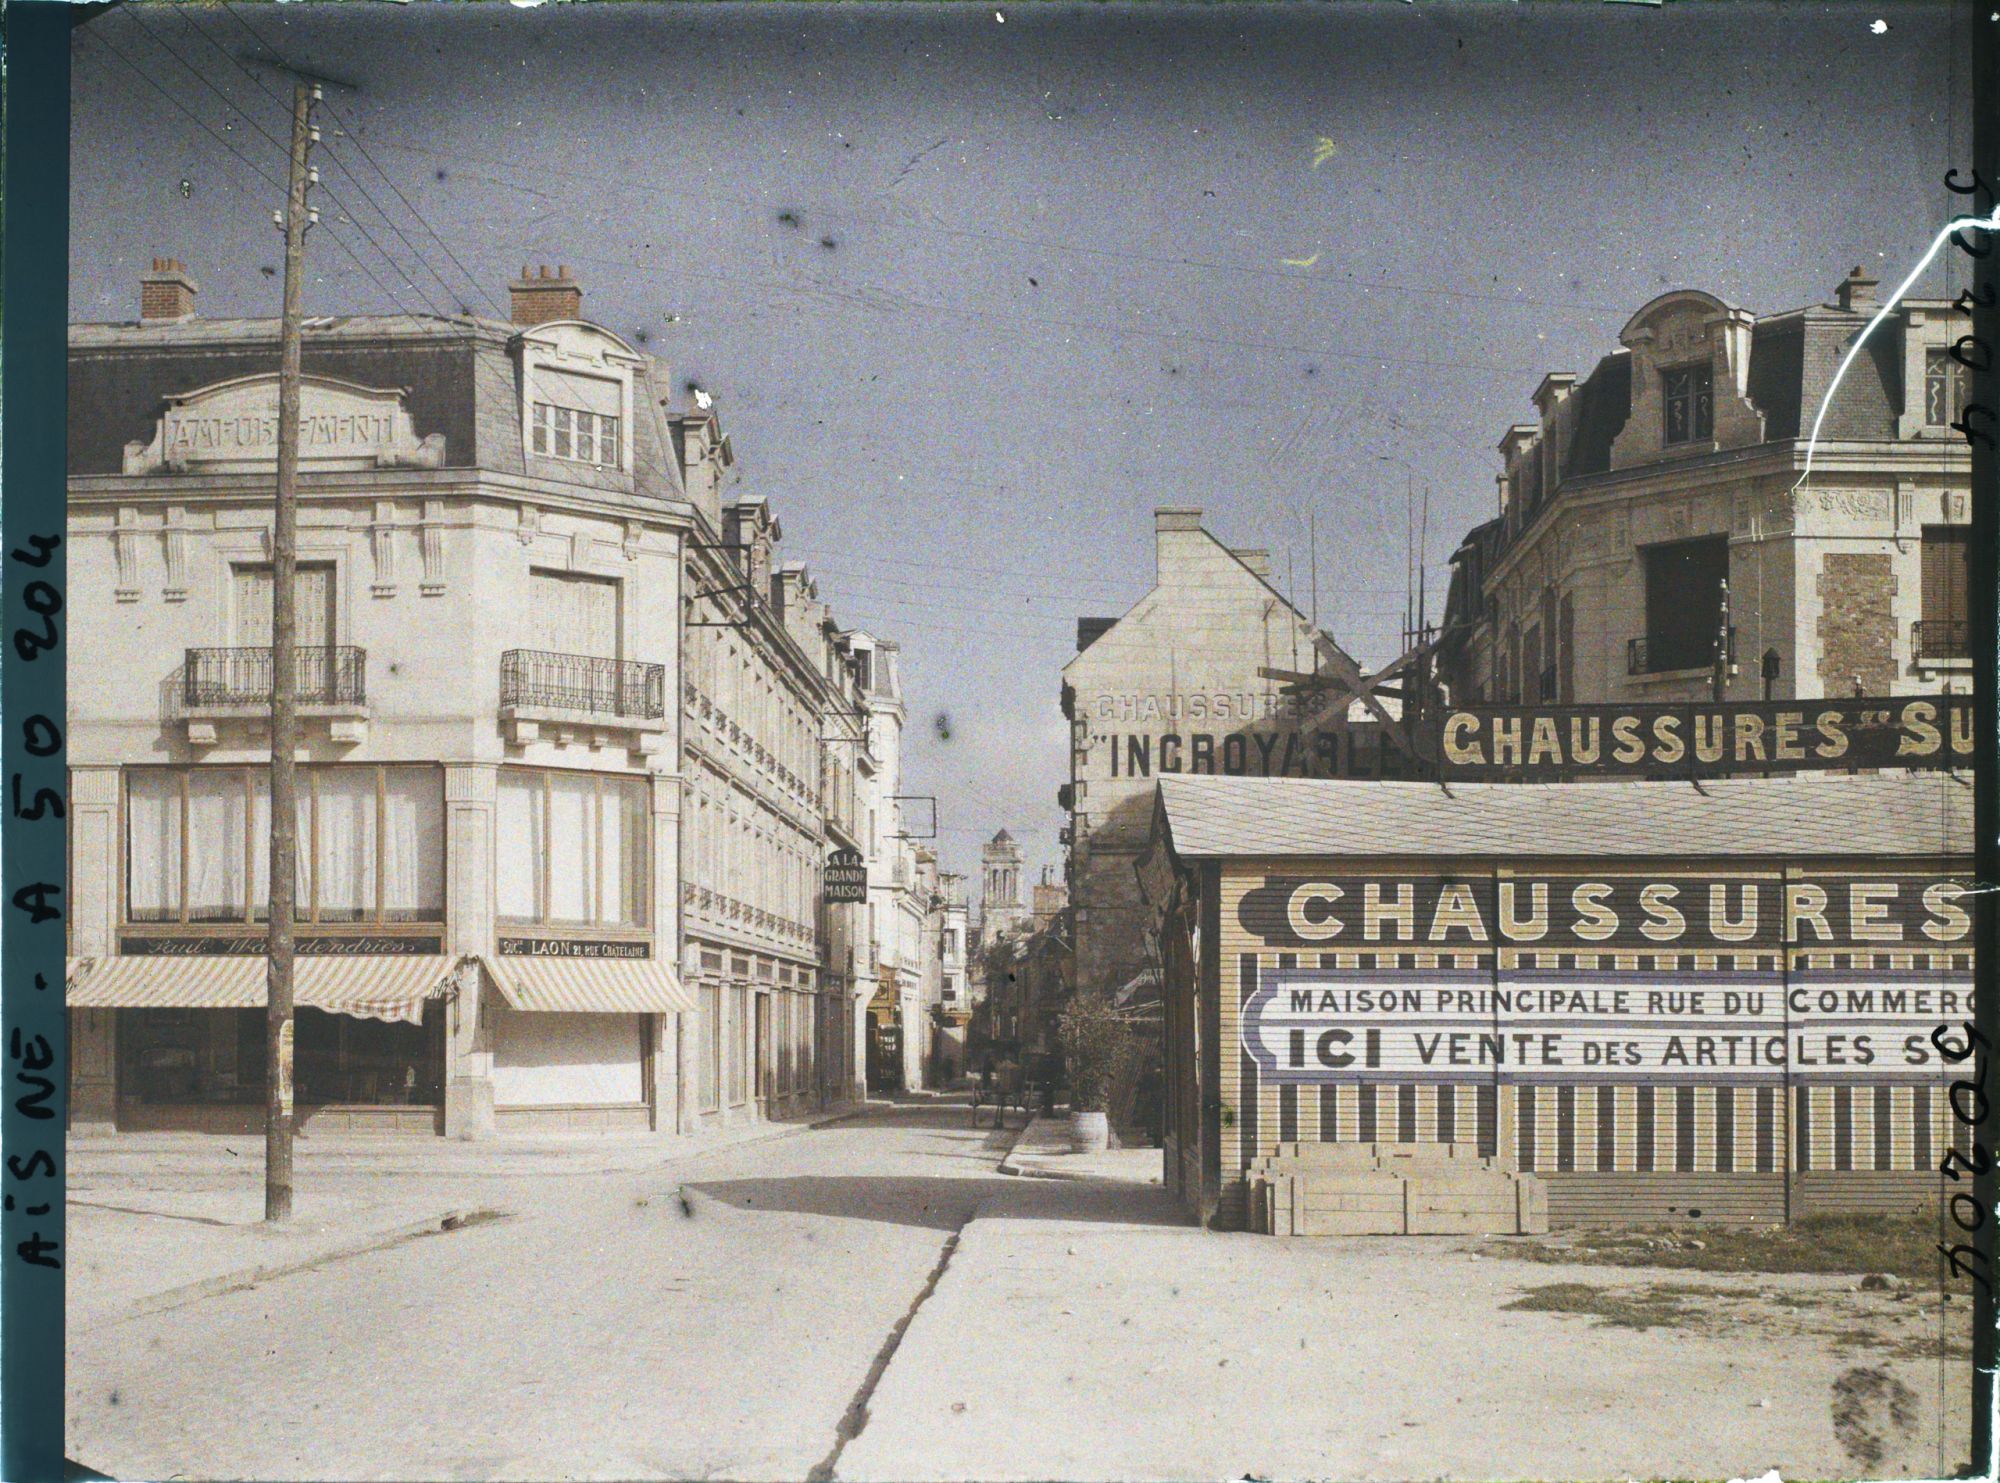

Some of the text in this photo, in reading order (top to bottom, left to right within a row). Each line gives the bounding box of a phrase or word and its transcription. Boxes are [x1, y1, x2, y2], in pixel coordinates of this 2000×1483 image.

[1443, 711, 1850, 766] CHAUSSURES
[832, 853, 858, 866] A LA
[824, 869, 866, 882] GRANDE
[824, 885, 866, 898] MAISON
[1286, 882, 1971, 943] CHAUSSURES
[531, 940, 570, 955] LAON
[585, 946, 600, 957] RUE
[1290, 989, 1422, 1014] MAISON
[1437, 989, 1631, 1015] PRINCIPALE
[1647, 991, 1706, 1015] RUE
[1723, 991, 1765, 1015] DU
[1290, 1029, 1382, 1069] ICI
[1415, 1033, 1564, 1066] VENTE
[1583, 1040, 1643, 1066] DES
[1661, 1035, 1876, 1067] ARTICLES
[1930, 1020, 1993, 1297] 50204
